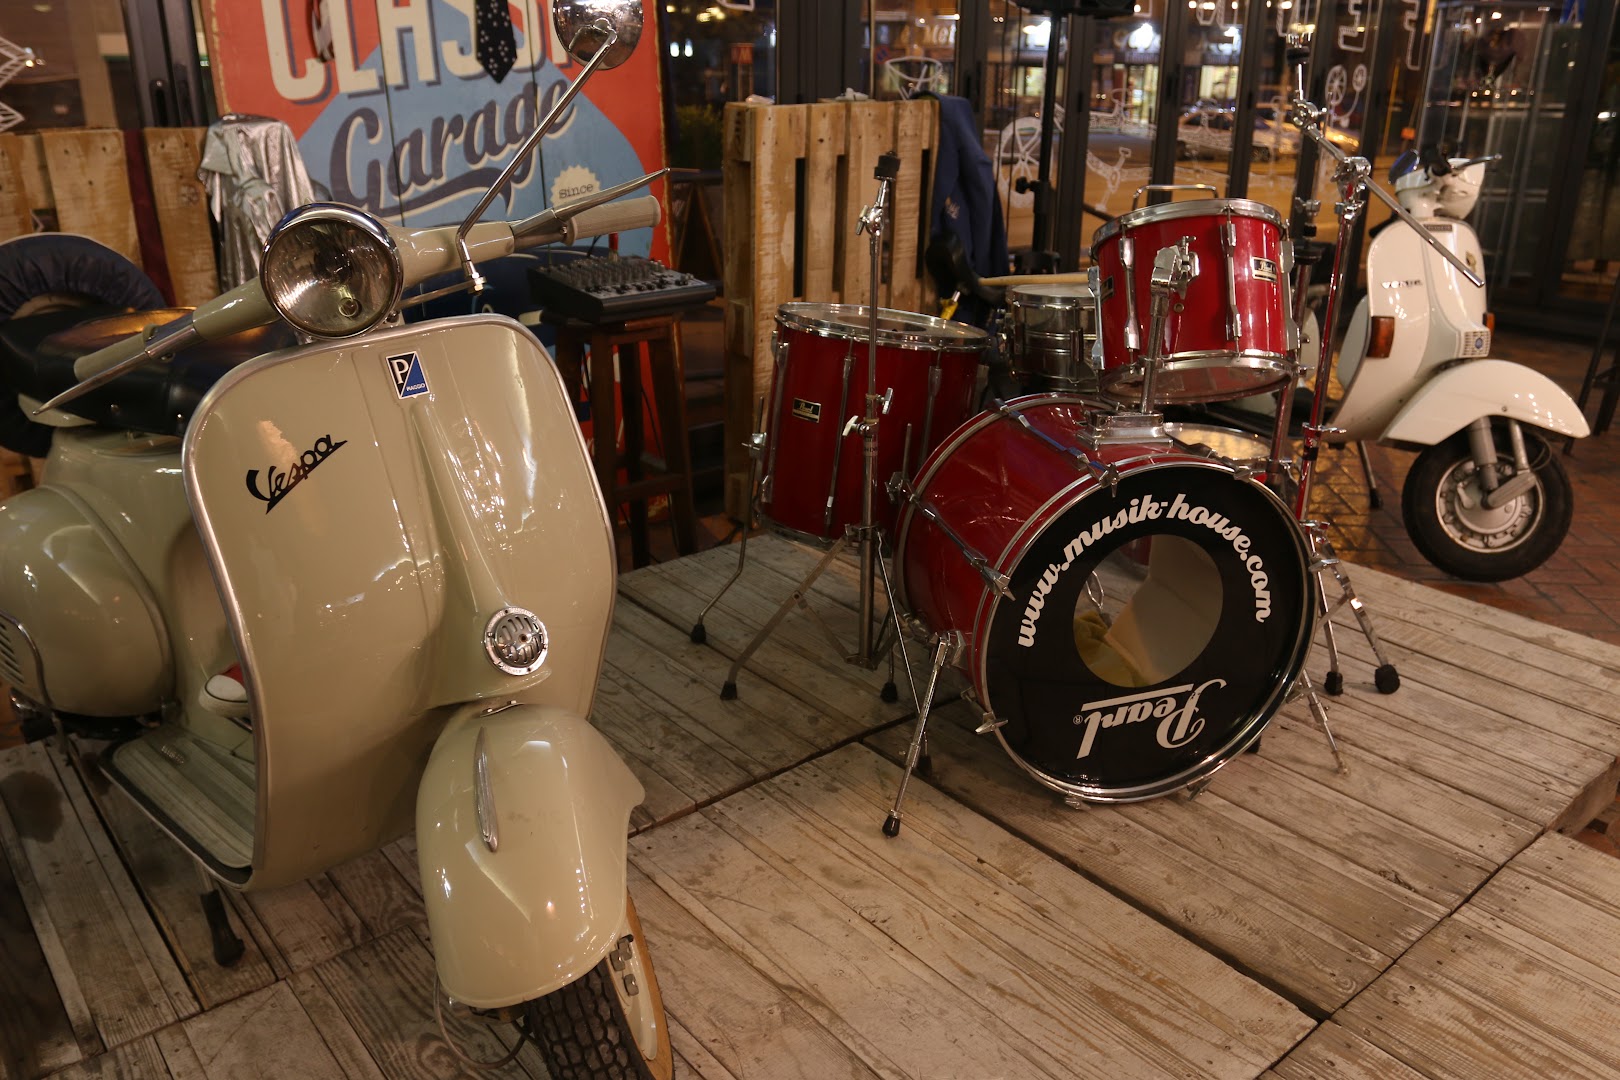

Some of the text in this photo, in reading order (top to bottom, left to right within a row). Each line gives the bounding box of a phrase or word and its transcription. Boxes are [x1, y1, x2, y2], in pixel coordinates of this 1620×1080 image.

[329, 79, 577, 220] Garage
[245, 433, 348, 515] Vespa
[1017, 493, 1272, 648] www.musik-house.com
